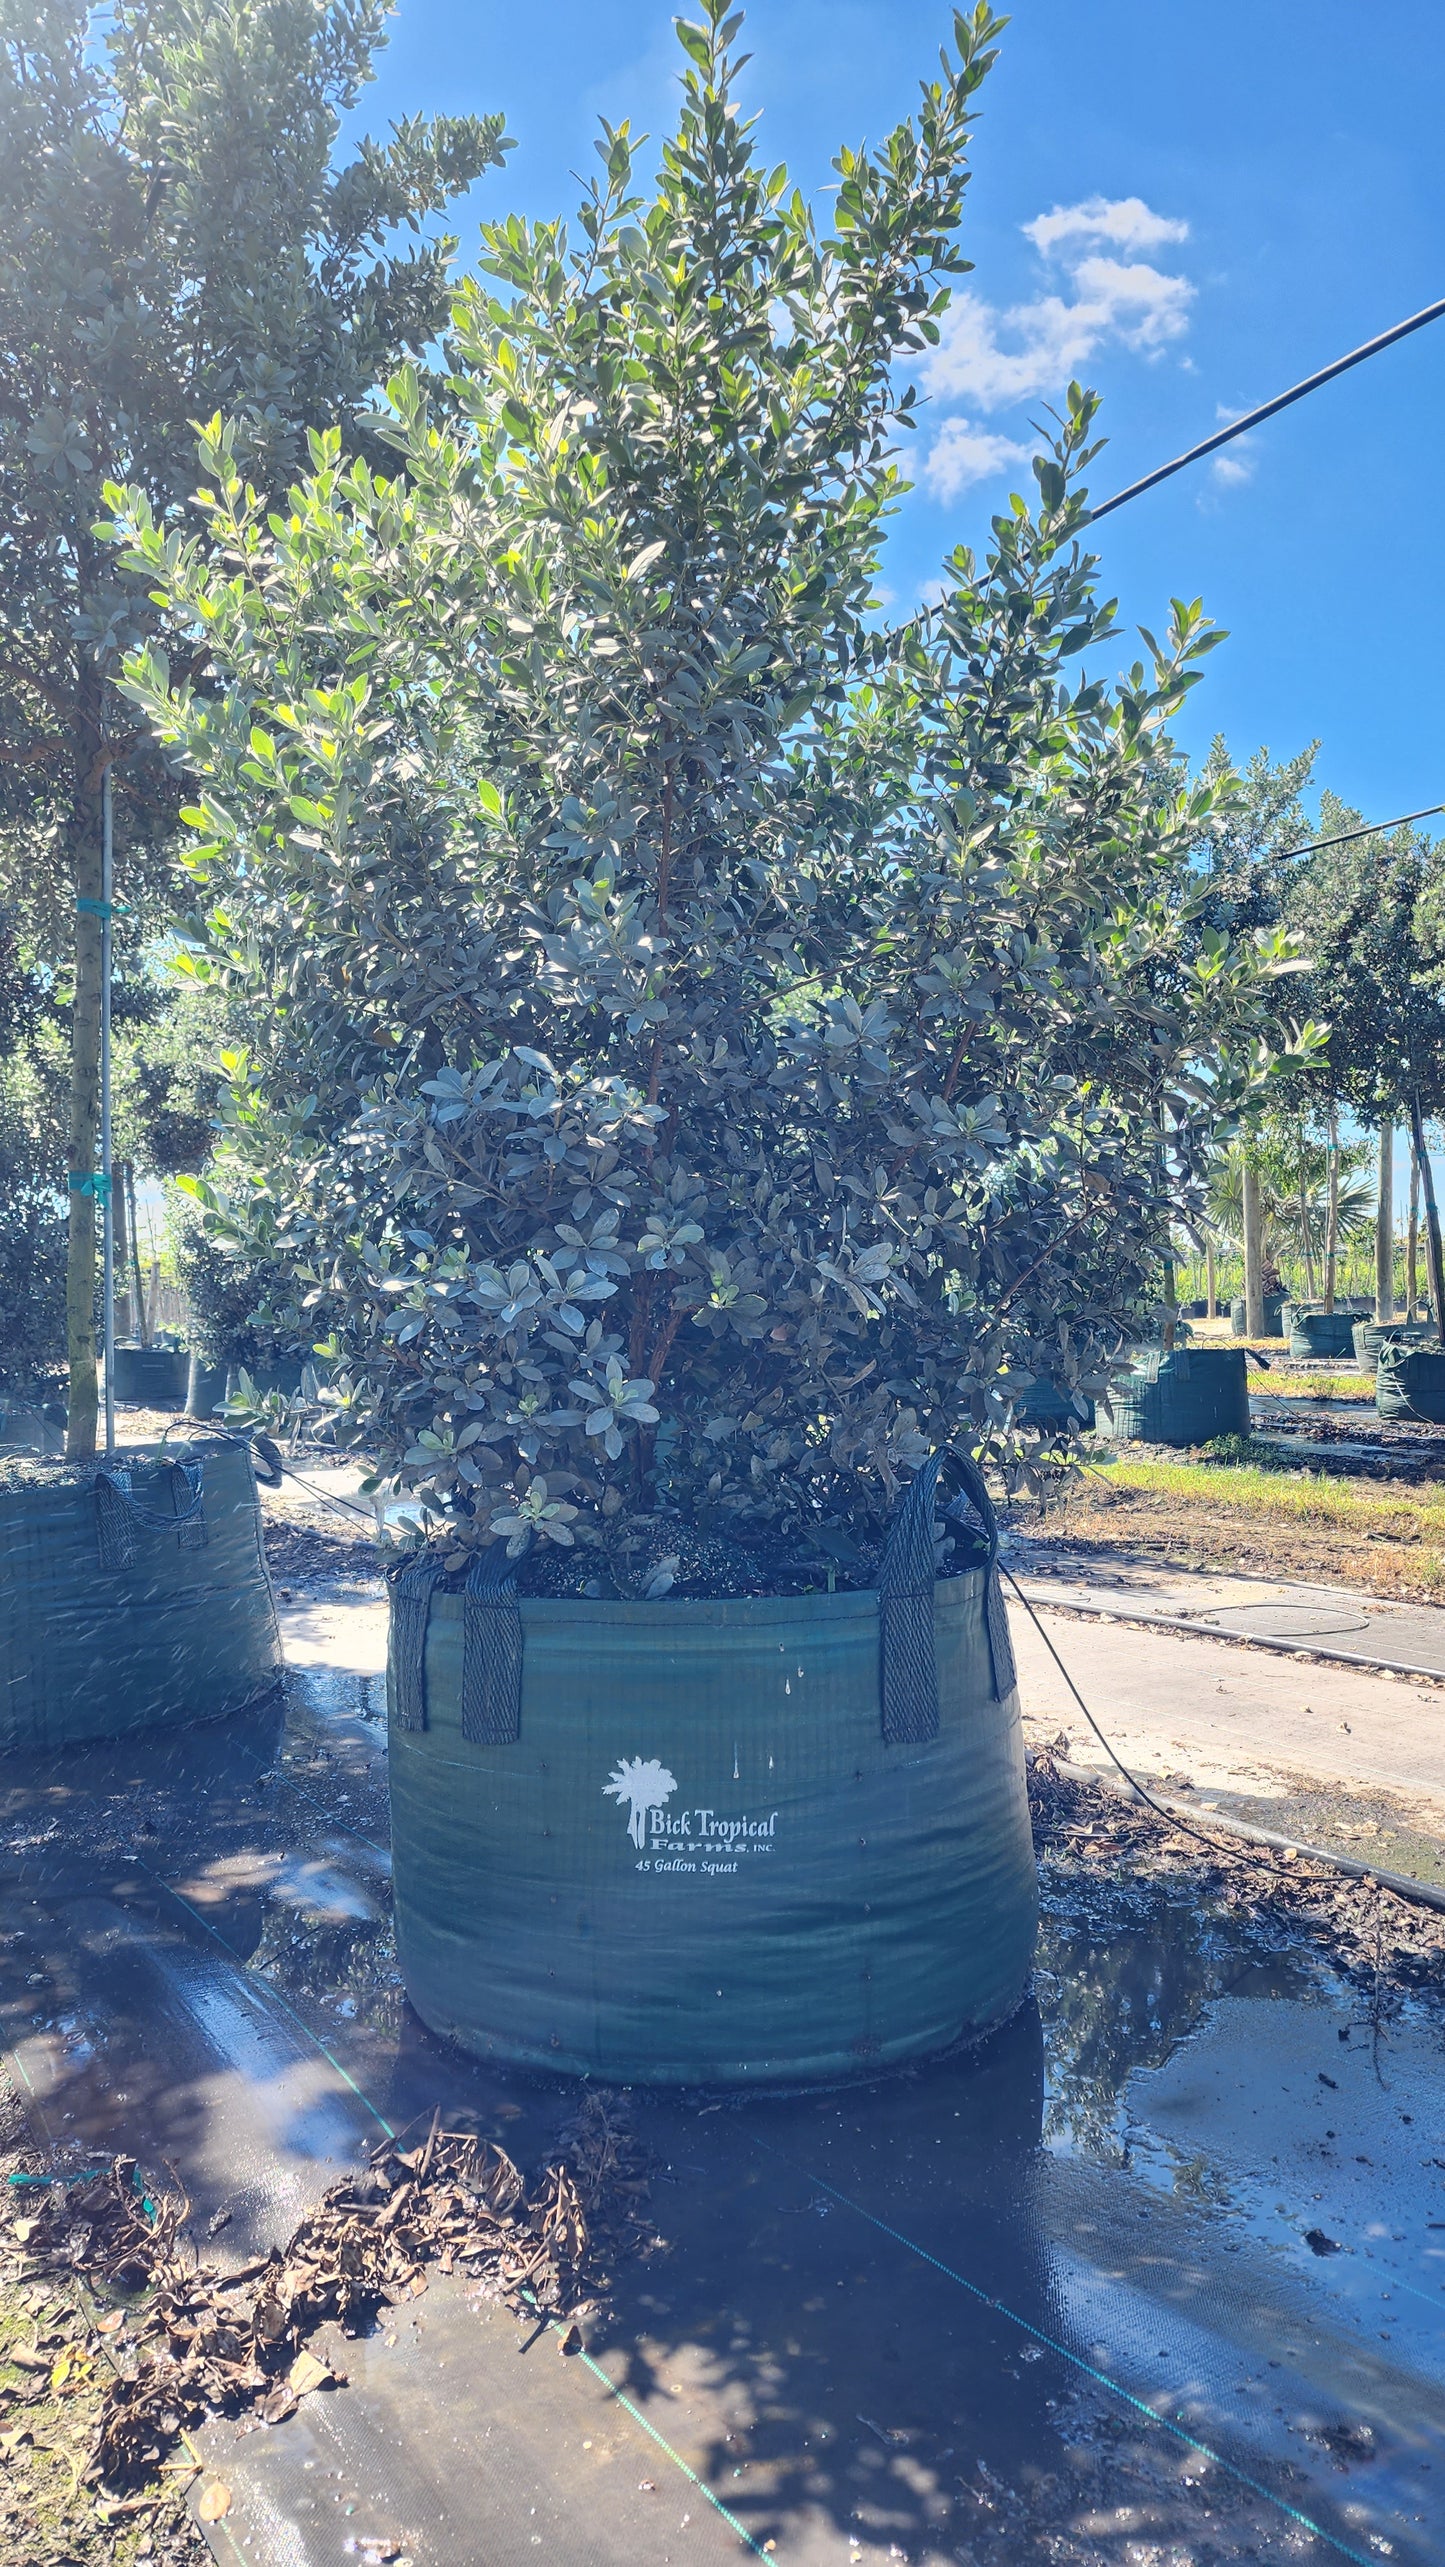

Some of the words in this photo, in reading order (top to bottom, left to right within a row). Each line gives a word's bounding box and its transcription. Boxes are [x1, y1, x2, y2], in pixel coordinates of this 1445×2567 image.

[649, 1809, 691, 1836] Bick
[694, 1809, 779, 1844] Tropical
[635, 1860, 652, 1872] 45
[654, 1859, 697, 1873] Gallon
[700, 1861, 738, 1876] Squat
